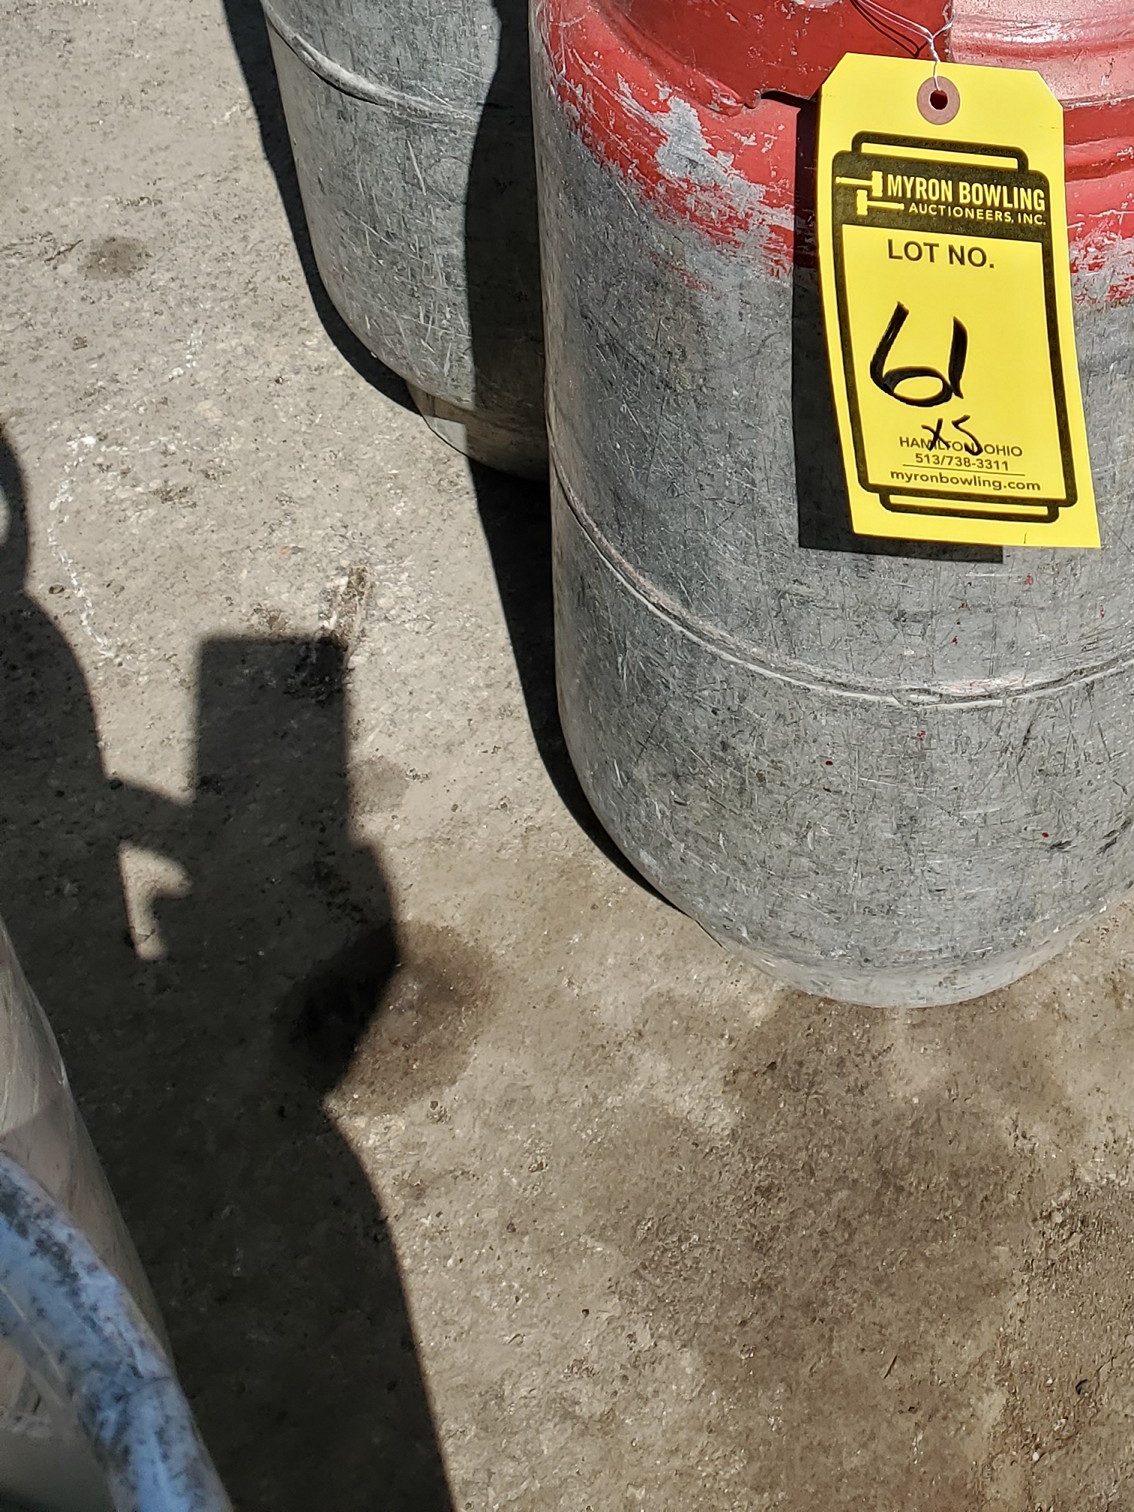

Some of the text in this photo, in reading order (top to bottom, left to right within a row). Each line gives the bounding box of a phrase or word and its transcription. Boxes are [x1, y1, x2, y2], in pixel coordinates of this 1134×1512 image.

[887, 173, 1046, 212] MYRON BOWLING
[908, 202, 1047, 226] AUCTIONEERS, INC.
[888, 238, 996, 269] LOT NO.
[869, 301, 968, 407] 61
[915, 452, 1009, 471] 513/738-3311
[984, 444, 1023, 457] OHIO
[890, 470, 1041, 491] myronbowling.com
